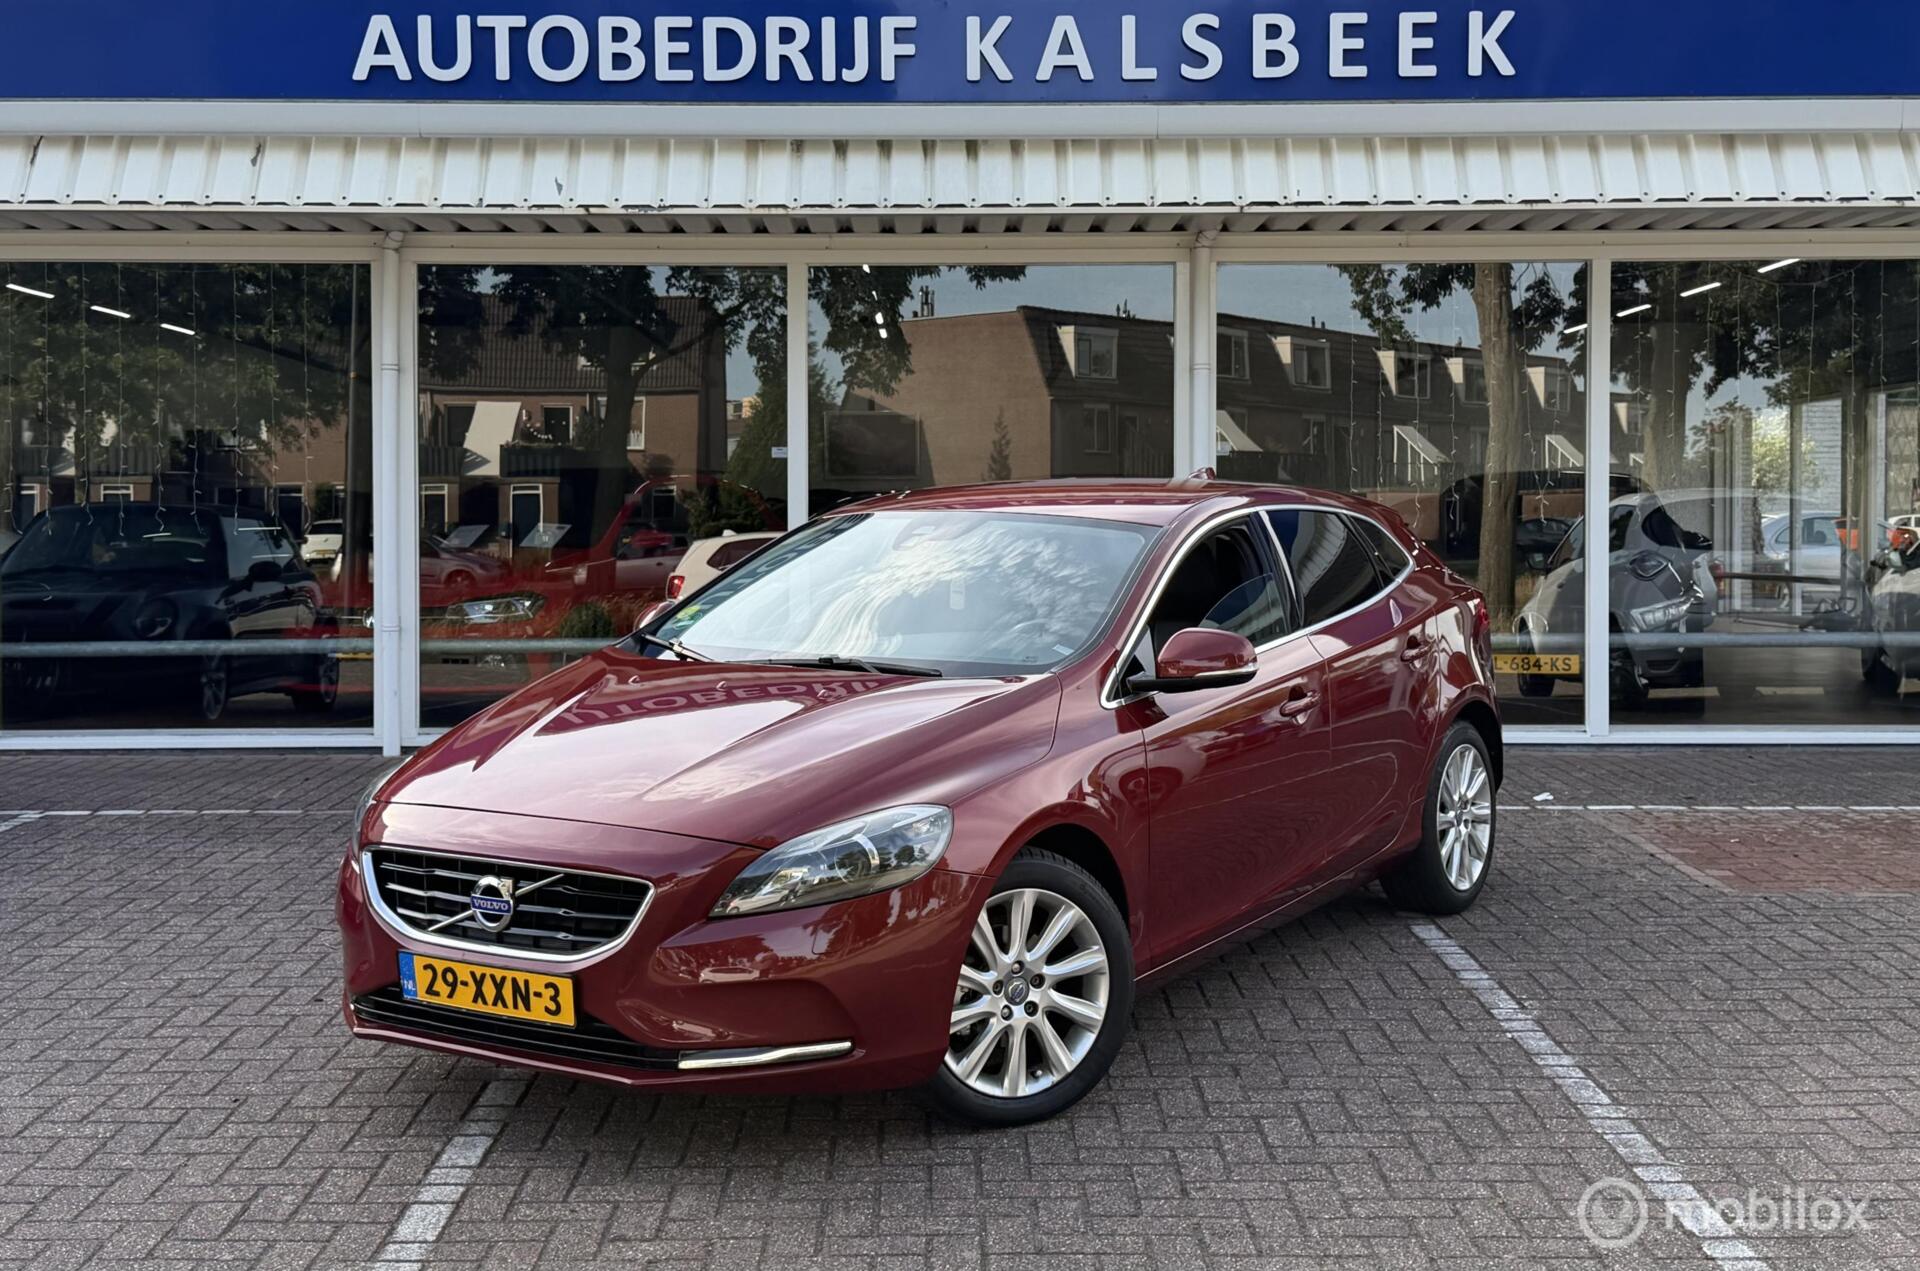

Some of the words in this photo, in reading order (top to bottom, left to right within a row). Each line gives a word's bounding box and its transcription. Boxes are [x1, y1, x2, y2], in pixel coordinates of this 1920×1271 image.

[353, 15, 916, 83] AUTOBEDRIJF
[1494, 656, 1572, 672] L-684-KS
[473, 898, 509, 911] VOLVO
[403, 979, 416, 991] NL
[422, 963, 562, 1017] 29-XXN-3
